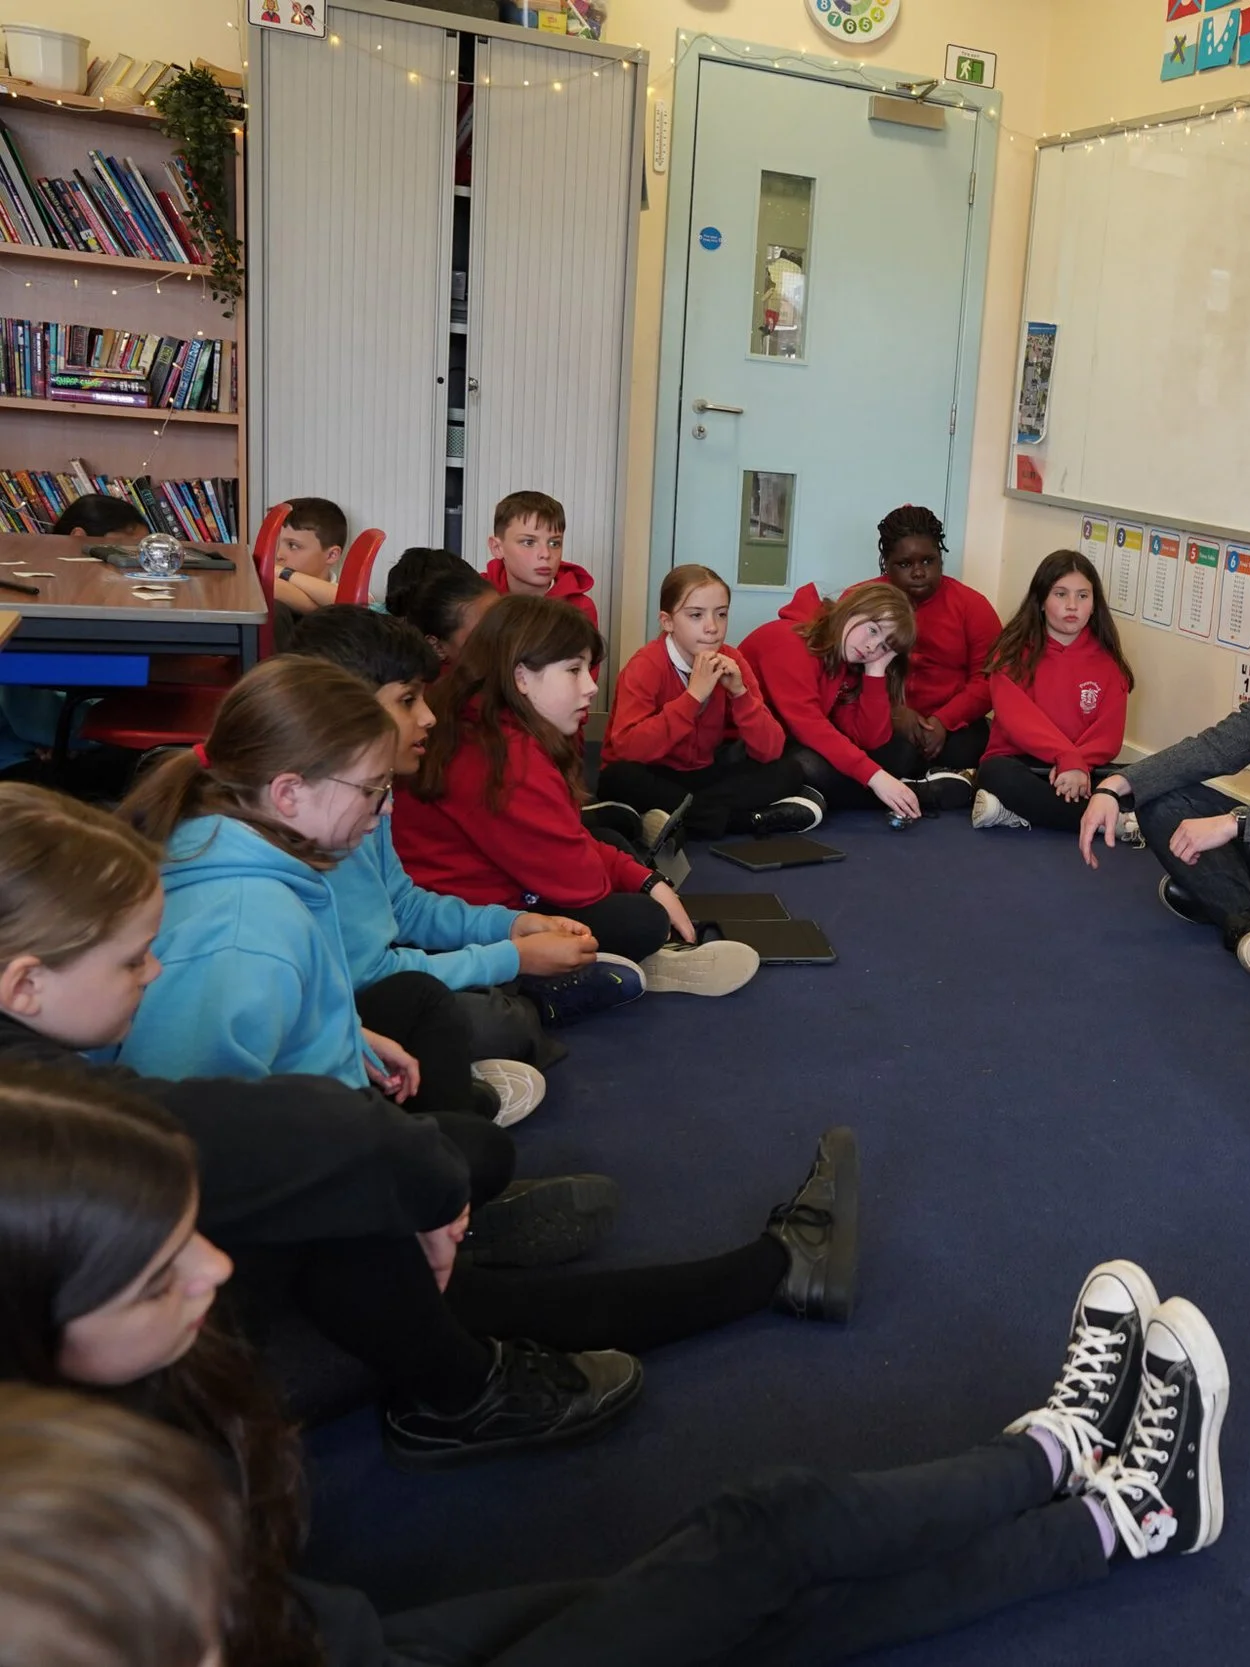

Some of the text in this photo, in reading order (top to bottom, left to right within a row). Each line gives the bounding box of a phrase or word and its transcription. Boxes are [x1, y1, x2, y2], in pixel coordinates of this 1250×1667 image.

[820, 0, 828, 9] 8
[831, 13, 839, 24] 7
[874, 9, 882, 19] 4
[846, 21, 854, 32] 6
[862, 19, 870, 30] 5
[1084, 525, 1091, 537] 2
[1118, 533, 1125, 545] 3
[1152, 540, 1159, 551] 4
[1190, 547, 1196, 560] 5
[1230, 555, 1237, 568] 6
[1244, 678, 1250, 693] 1
